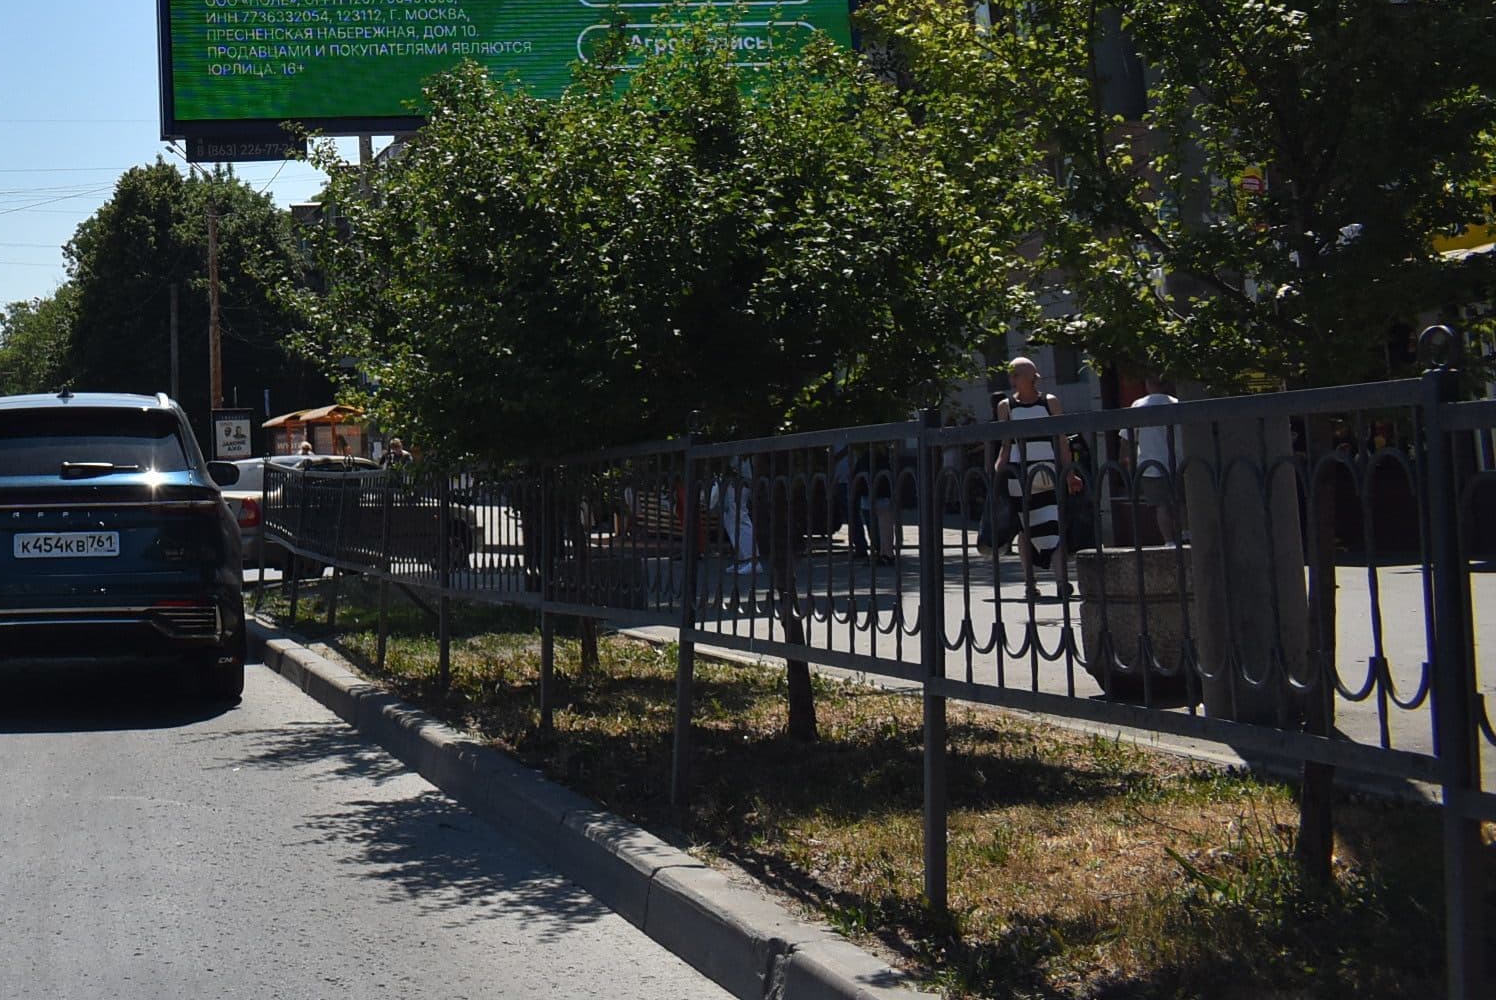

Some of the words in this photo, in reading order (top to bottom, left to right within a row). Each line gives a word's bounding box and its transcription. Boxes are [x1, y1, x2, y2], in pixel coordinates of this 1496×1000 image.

[206, 11, 240, 24] ИНН
[242, 10, 333, 24] 7736332054,
[336, 9, 386, 24] 123112,
[389, 9, 402, 21] Г.
[405, 8, 470, 22] МОСКВА,
[207, 27, 314, 41] ПРЕСНЕНСКАЯ
[317, 26, 420, 40] НАБЕРЕЖНАЯ,
[423, 25, 457, 40] ДОМ
[207, 44, 311, 60] ПРОДАВЦАМИ
[315, 44, 326, 57] И
[329, 43, 448, 57] ПОКУПАТЕЛЯМИ
[452, 41, 532, 55] ЯВЛЯЮТСЯ
[631, 34, 773, 56] Агроисы
[208, 63, 276, 78] ЮРЛИЦА.
[281, 62, 304, 76] 16+
[208, 143, 237, 157] (863)
[21, 537, 86, 553] К454КВ
[88, 535, 113, 548] 761
